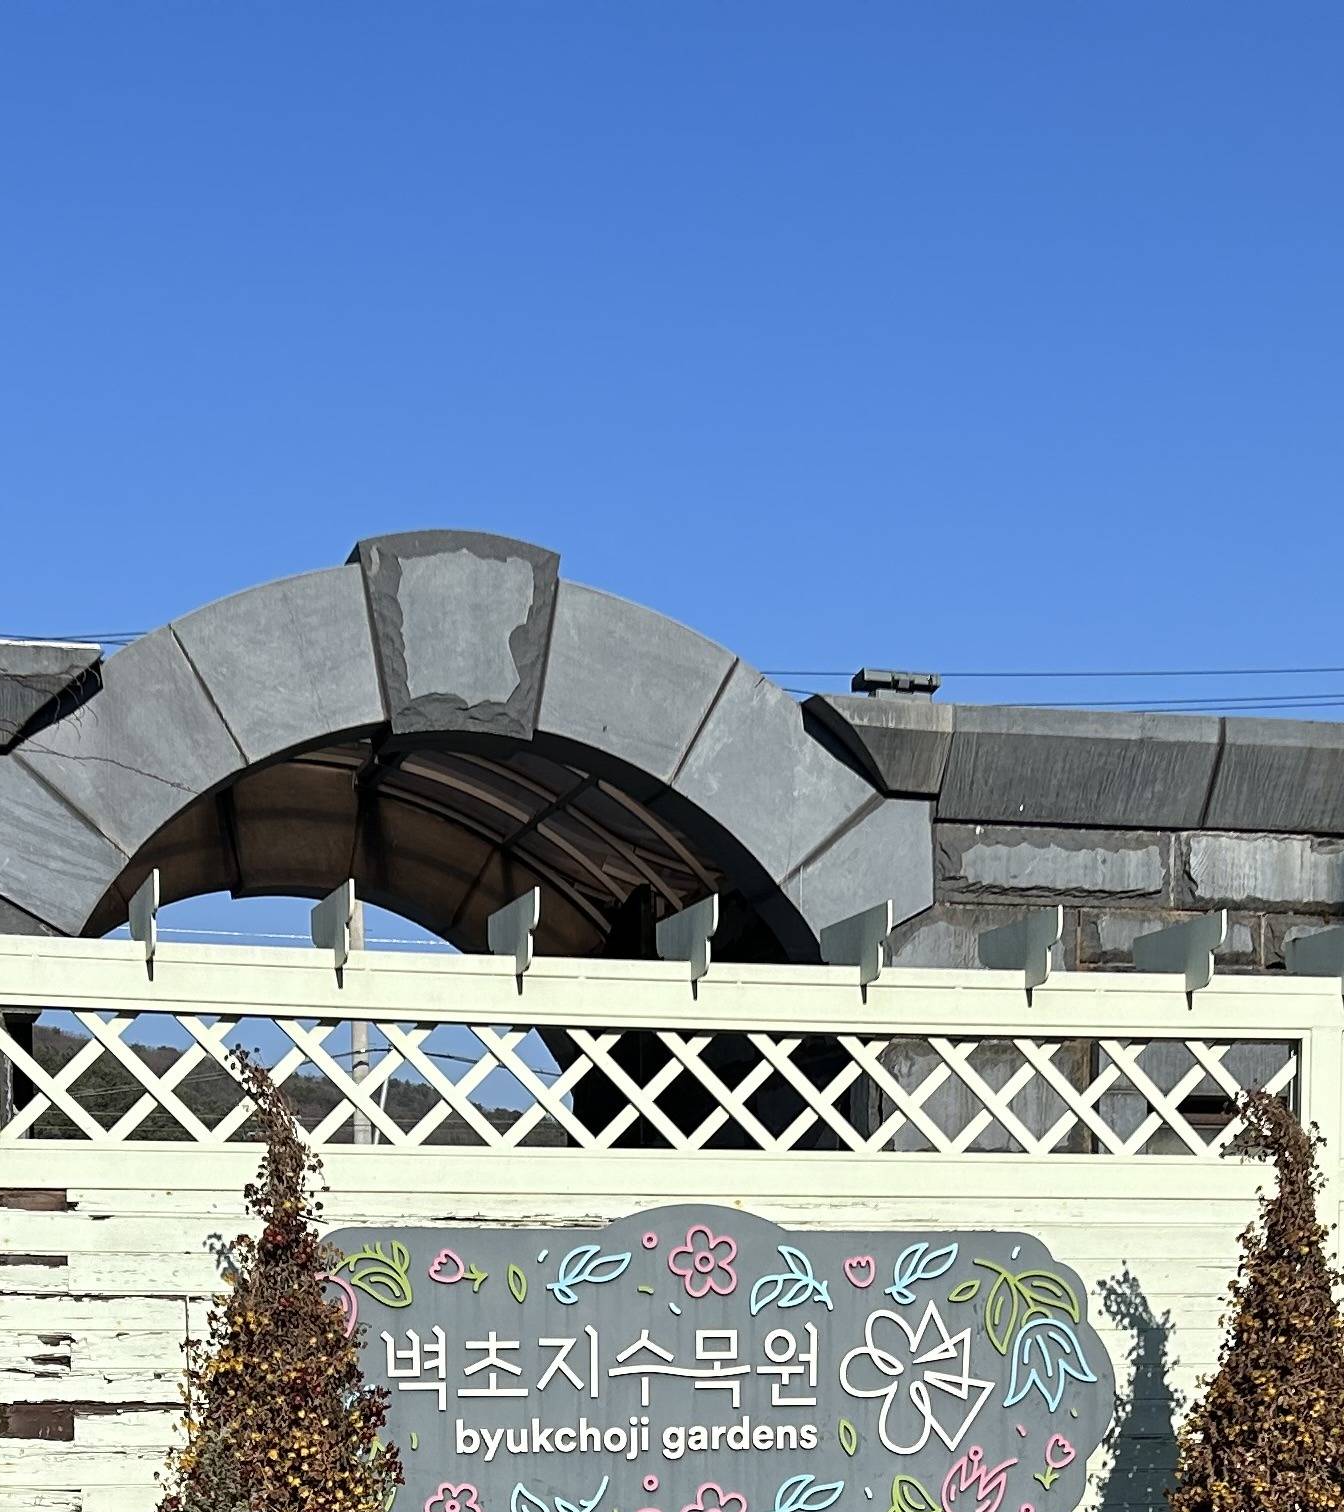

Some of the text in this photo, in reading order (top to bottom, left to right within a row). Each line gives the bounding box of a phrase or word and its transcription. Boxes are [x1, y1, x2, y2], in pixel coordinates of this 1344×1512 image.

[379, 1322, 818, 1411] 벽초지수목원
[456, 1416, 818, 1461] byukchoji gardens
